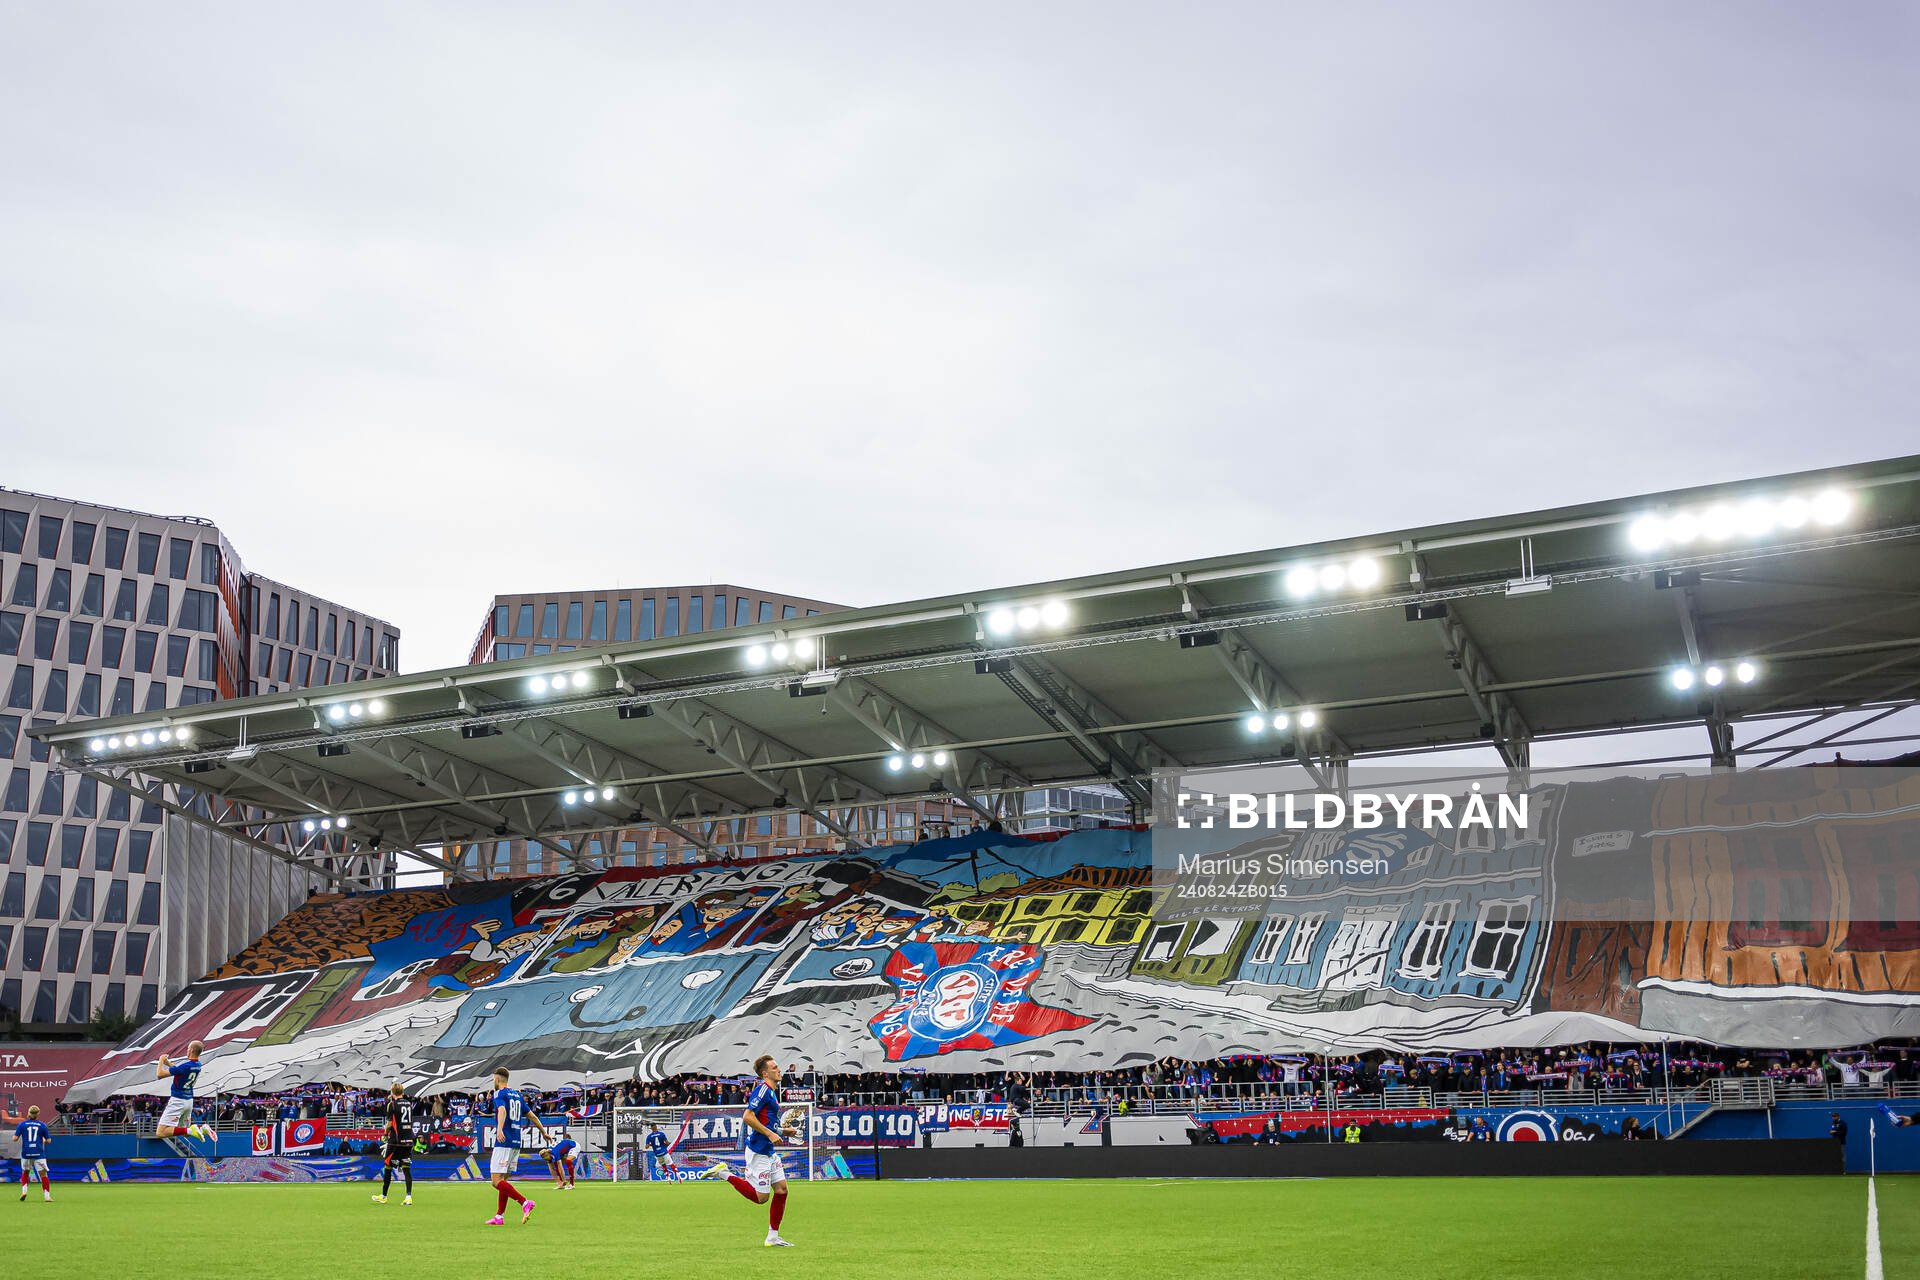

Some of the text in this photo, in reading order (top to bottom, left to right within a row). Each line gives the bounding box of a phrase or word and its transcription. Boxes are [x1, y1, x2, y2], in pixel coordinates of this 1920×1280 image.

[0, 1054, 29, 1067] TA
[4, 1080, 68, 1089] HANDLING
[401, 1105, 412, 1123] 21
[509, 1099, 521, 1122] 80
[27, 1126, 39, 1142] 17
[811, 1115, 874, 1137] OSLO
[654, 1136, 660, 1147] 4
